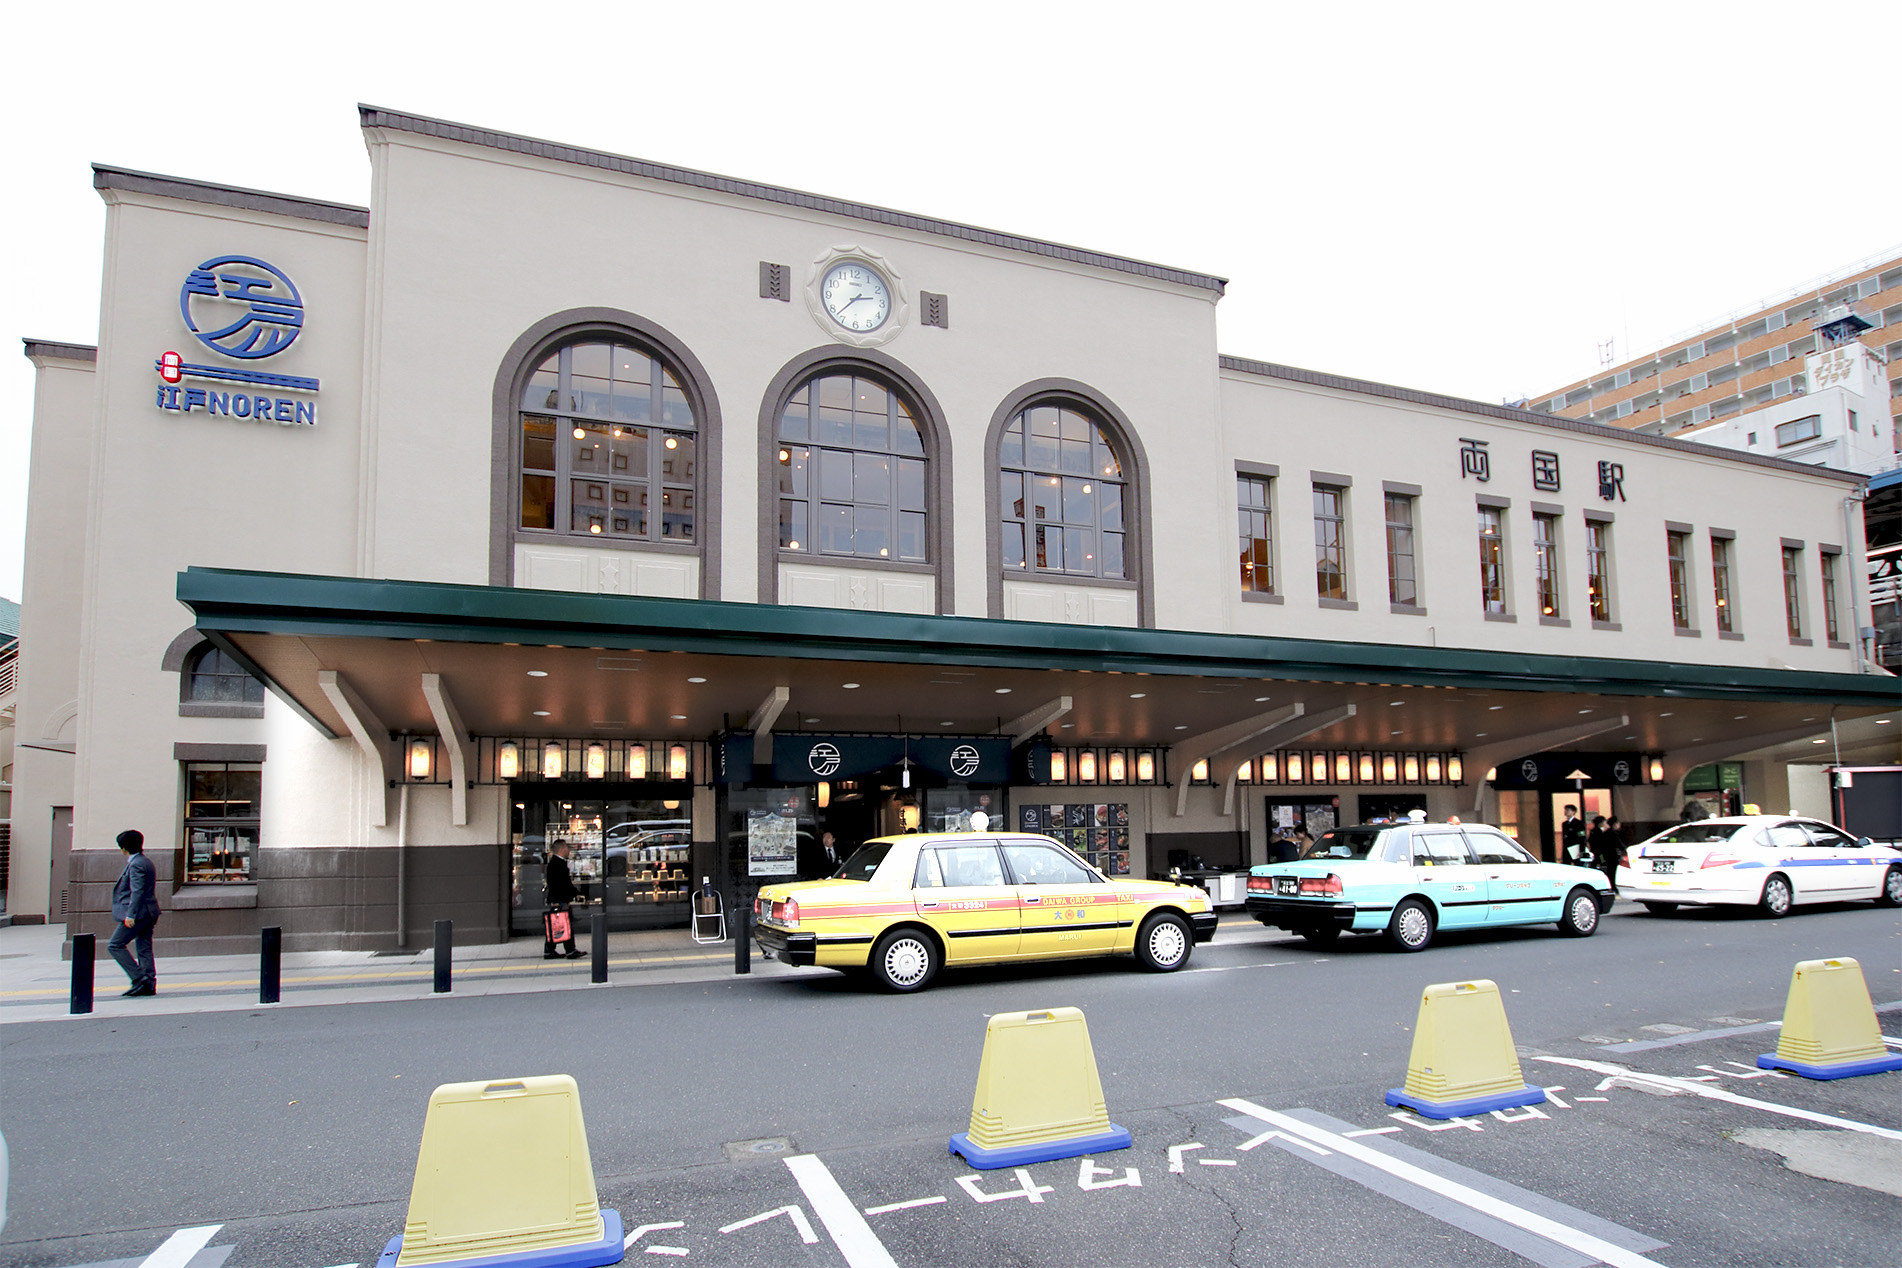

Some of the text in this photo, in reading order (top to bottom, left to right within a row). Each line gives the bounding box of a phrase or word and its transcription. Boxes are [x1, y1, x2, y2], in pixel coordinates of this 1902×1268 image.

[838, 271, 847, 280] 11
[850, 269, 861, 279] 12
[829, 279, 840, 288] 10
[865, 275, 870, 284] 1
[825, 290, 832, 299] 9
[874, 285, 881, 295] 2
[829, 304, 837, 313] 8
[879, 299, 886, 309] 3
[839, 315, 846, 324] 7
[874, 311, 881, 320] 4
[852, 320, 859, 329] 6
[865, 319, 873, 328] 5
[1459, 437, 1626, 502] 両国駅
[1042, 894, 1134, 906] DAIWA GROUP TAXI
[1058, 934, 1082, 942] MARUI
